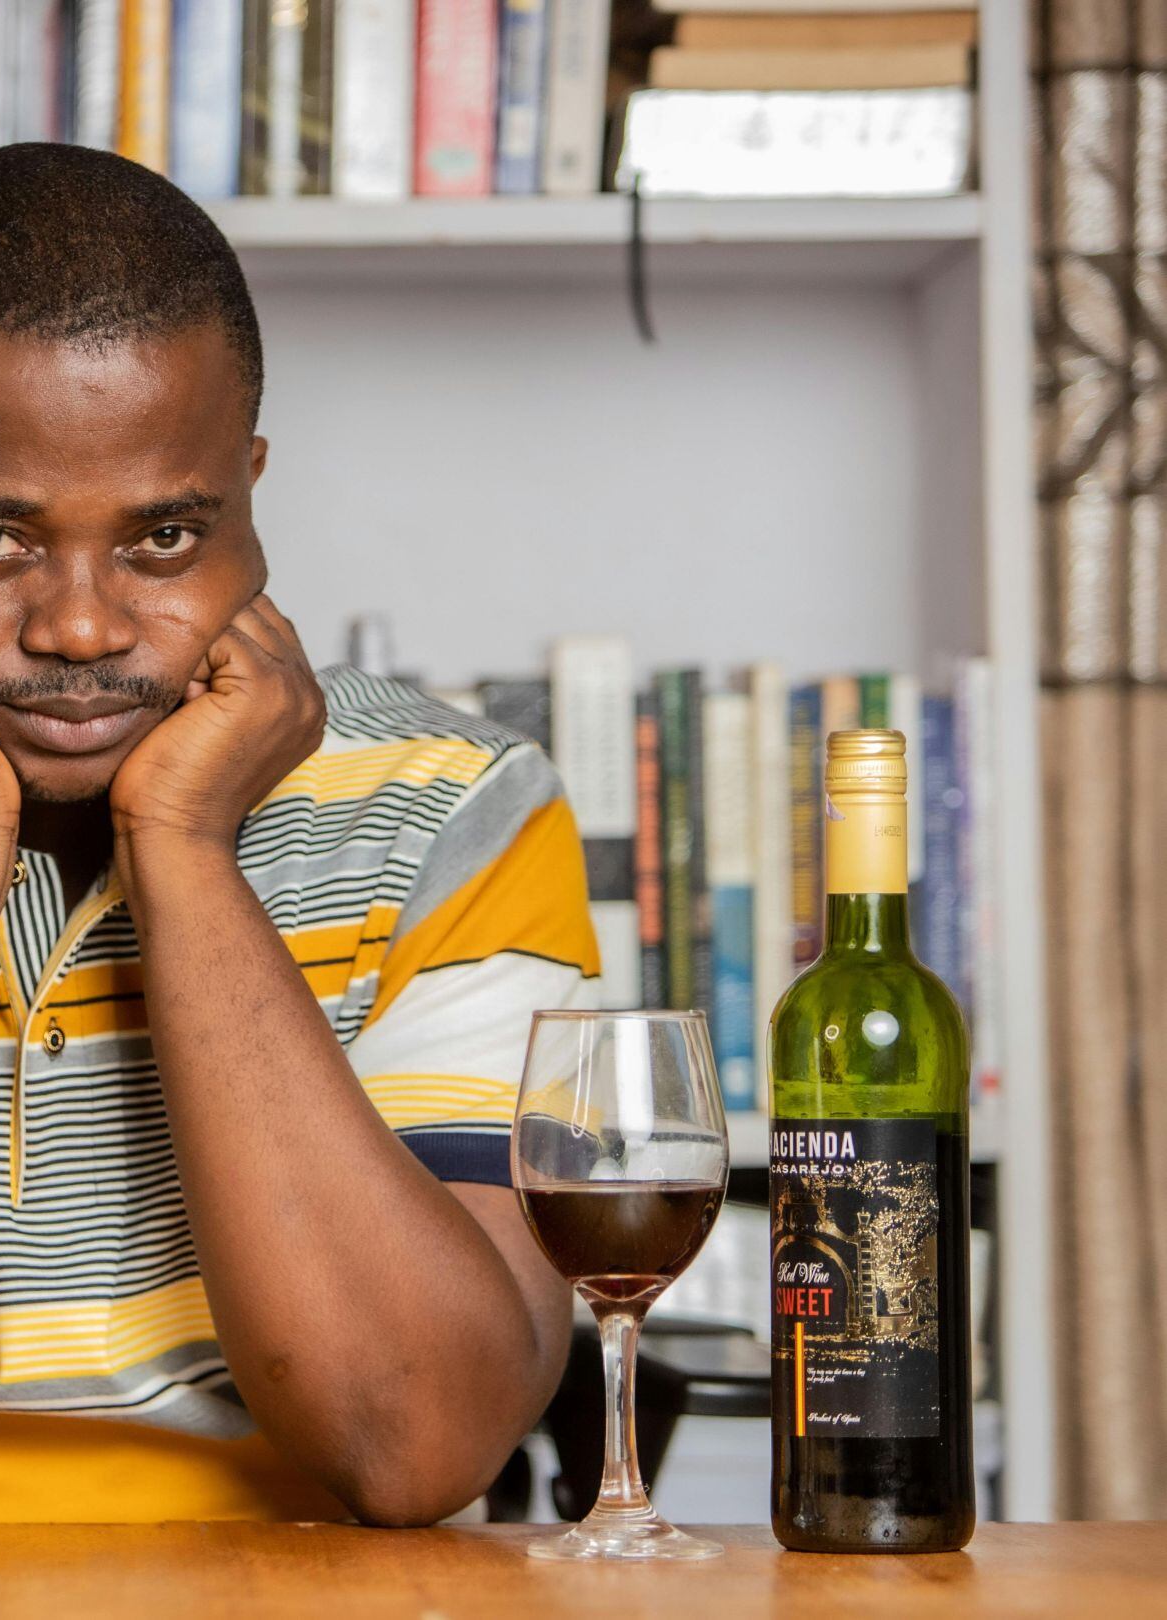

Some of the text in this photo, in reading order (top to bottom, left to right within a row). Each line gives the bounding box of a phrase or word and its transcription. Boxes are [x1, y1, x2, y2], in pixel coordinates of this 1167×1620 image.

[777, 1262, 830, 1283] Red Wine
[776, 1287, 833, 1316] SWEET
[807, 1412, 831, 1422] Product
[832, 1413, 842, 1425] of
